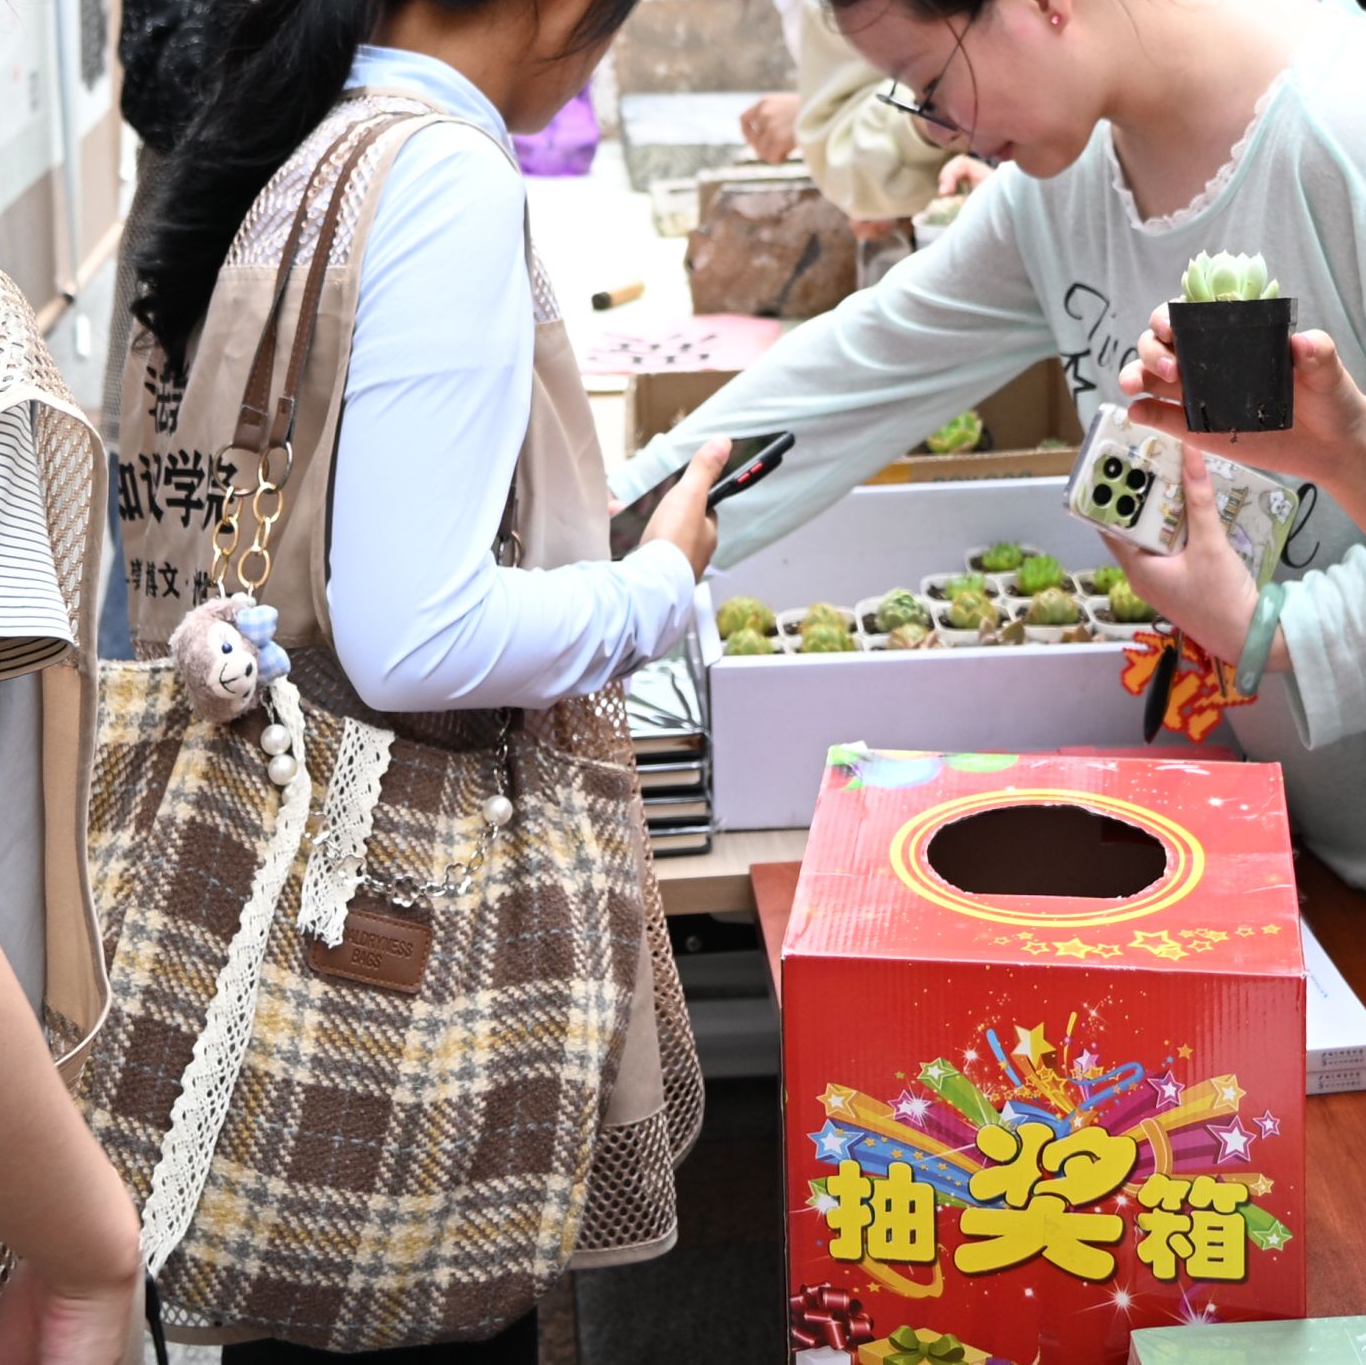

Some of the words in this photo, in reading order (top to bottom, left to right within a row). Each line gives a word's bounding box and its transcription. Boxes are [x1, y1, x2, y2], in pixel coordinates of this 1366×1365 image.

[351, 948, 383, 969] BAGS
[825, 1121, 1253, 1282] 抽奖箱
